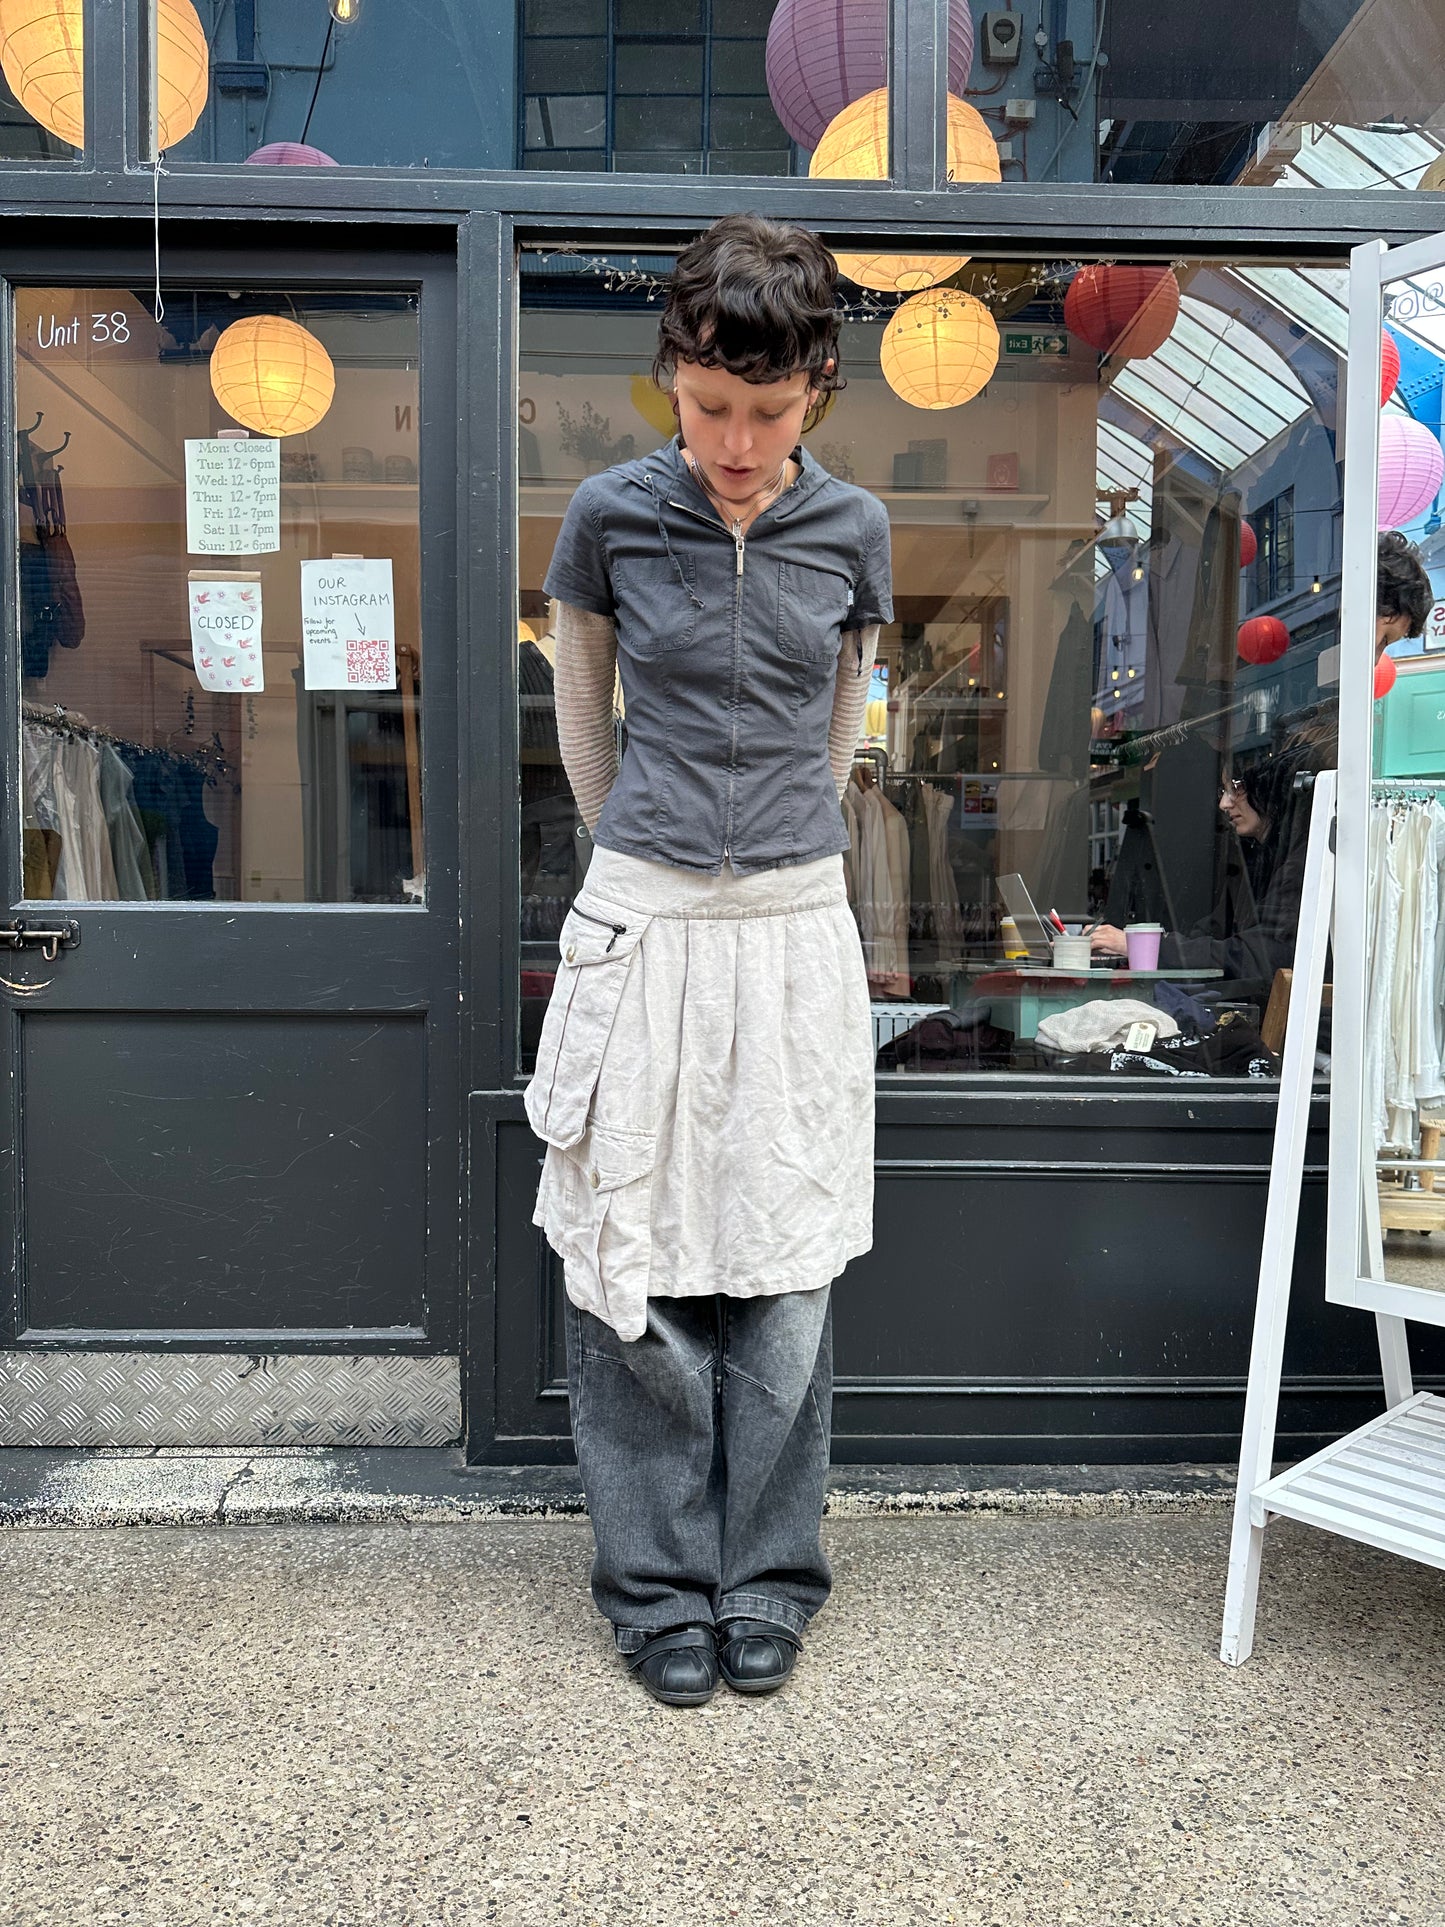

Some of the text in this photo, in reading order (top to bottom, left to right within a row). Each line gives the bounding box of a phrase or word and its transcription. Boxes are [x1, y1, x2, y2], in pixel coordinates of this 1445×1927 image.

[38, 312, 130, 348] Unit 38
[198, 441, 272, 453] Mon: Closed
[197, 458, 224, 469] Tue:
[195, 475, 228, 486] Wed:
[193, 491, 222, 502] Thu:
[203, 507, 224, 518] Fri:
[203, 524, 225, 535] Sat:
[199, 540, 225, 551] Sun:
[318, 577, 347, 589] OUR
[313, 593, 390, 606] INSTAGRAM
[198, 615, 254, 630] CLOSED
[324, 617, 335, 629] for
[306, 628, 338, 639] upcoming
